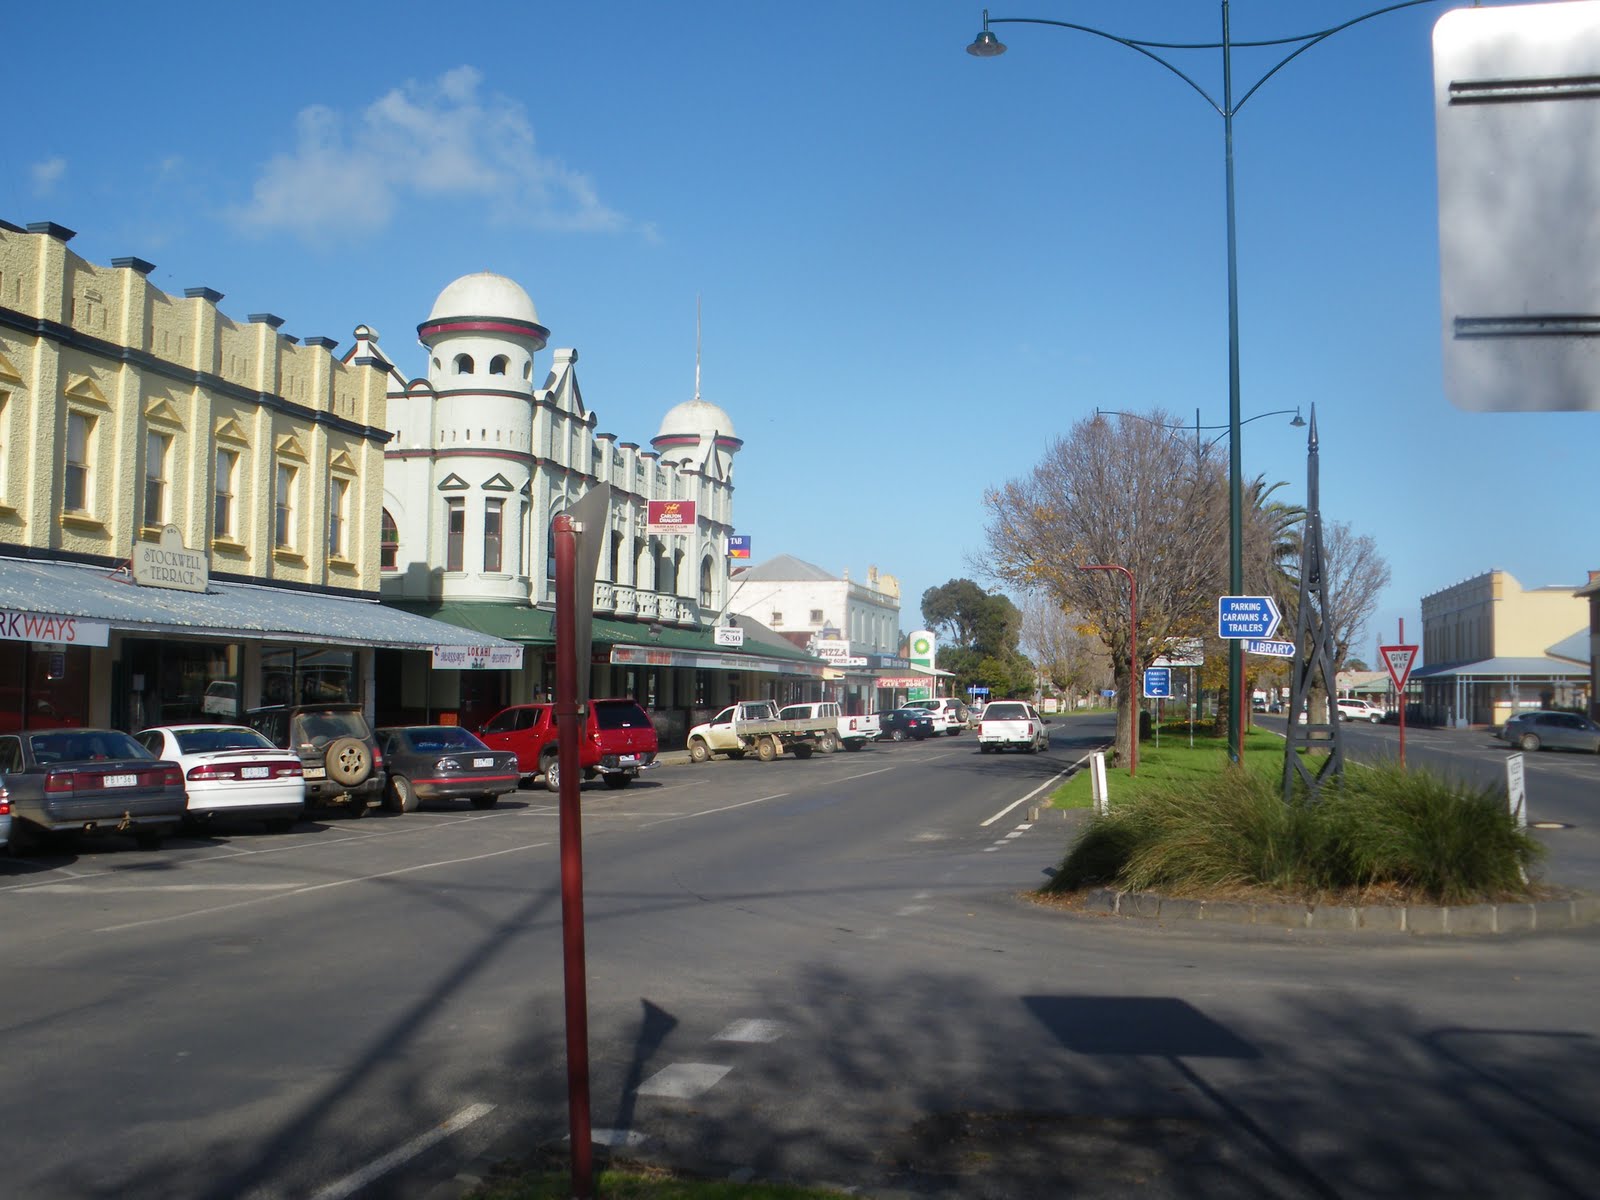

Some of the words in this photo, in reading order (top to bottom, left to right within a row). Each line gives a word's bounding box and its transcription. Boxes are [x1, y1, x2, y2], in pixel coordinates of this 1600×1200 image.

[730, 537, 742, 545] TAB
[144, 548, 201, 570] STOCKWELL
[150, 565, 195, 585] TERRACE
[1230, 602, 1261, 611] PARKING
[1222, 613, 1259, 622] CARAVANS
[1262, 613, 1269, 622] &
[1229, 623, 1263, 632] TRAILERS
[1250, 641, 1290, 654] LIBRARY
[820, 648, 847, 657] PIZZA
[1391, 653, 1408, 662] GIVE
